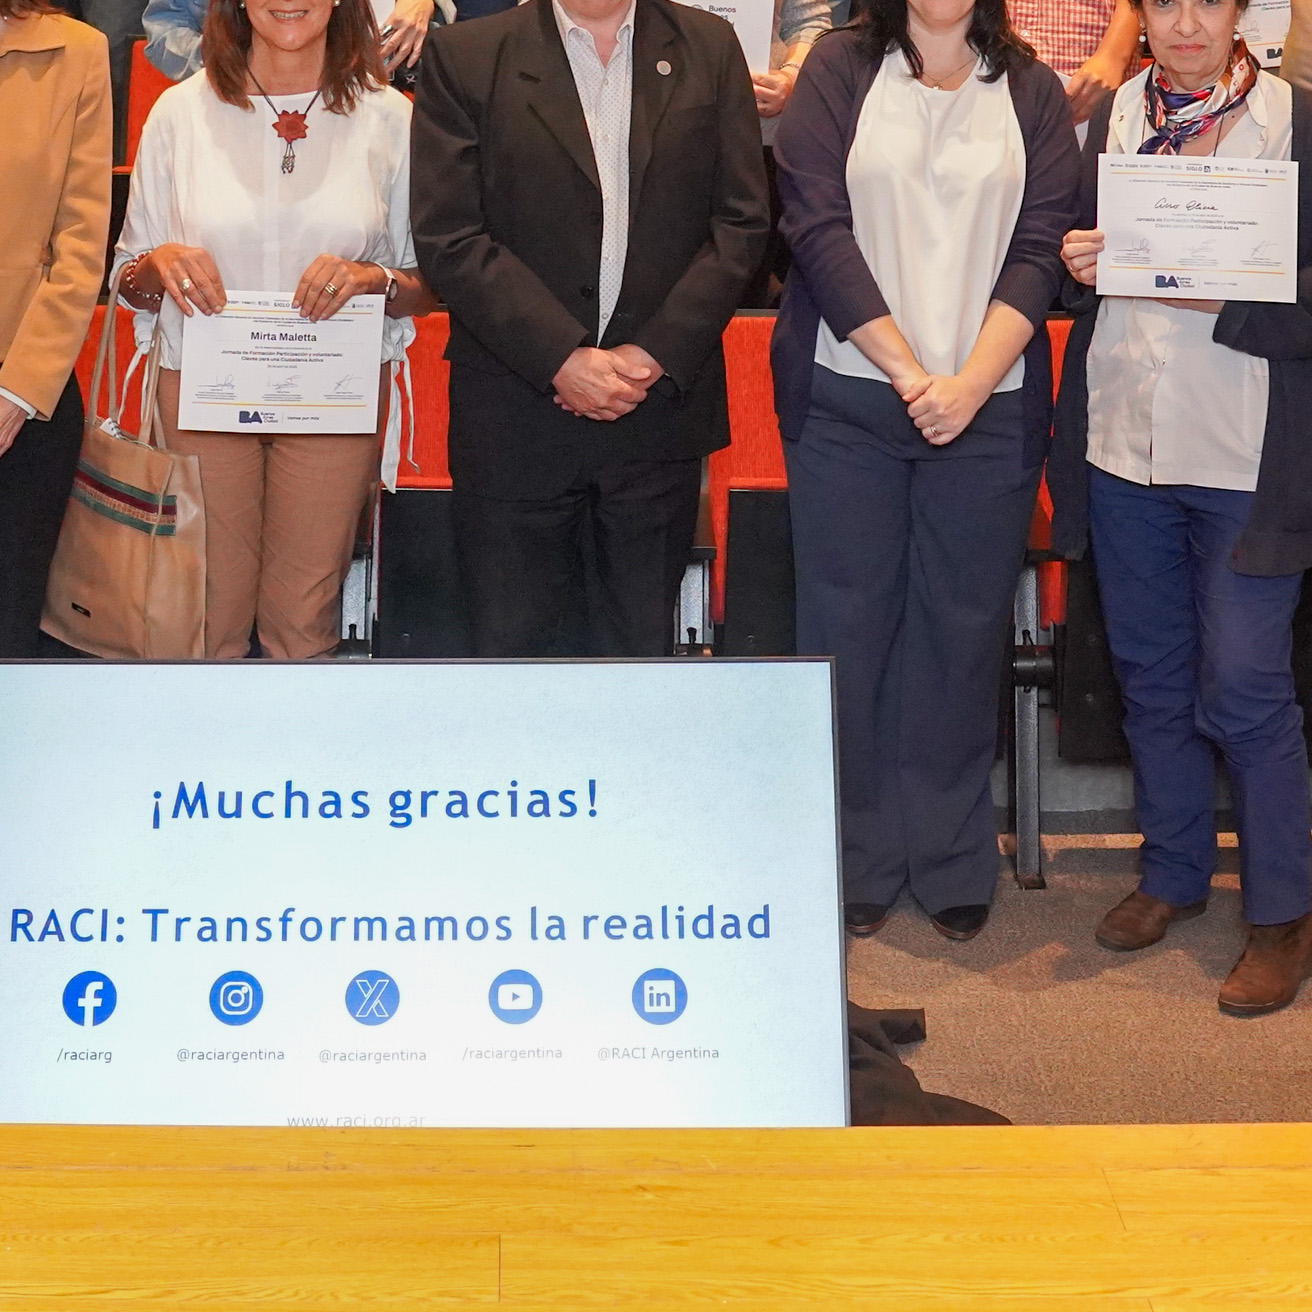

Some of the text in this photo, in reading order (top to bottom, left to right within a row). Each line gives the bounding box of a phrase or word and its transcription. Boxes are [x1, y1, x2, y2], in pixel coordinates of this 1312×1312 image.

[708, 5, 737, 13] Buenos
[1155, 275, 1179, 289] BA
[250, 331, 317, 342] Mirta Maletta
[238, 410, 263, 424] BA
[152, 778, 599, 830] ¡Muchas gracias!
[9, 903, 771, 944] RACI: Transformamos la realidad
[56, 1048, 113, 1064] /raciarg
[176, 1048, 285, 1064] @raciargentina
[318, 1049, 427, 1065] @raciargentina
[462, 1046, 563, 1062] /raciargentina
[597, 1046, 720, 1062] @RACI Argentina
